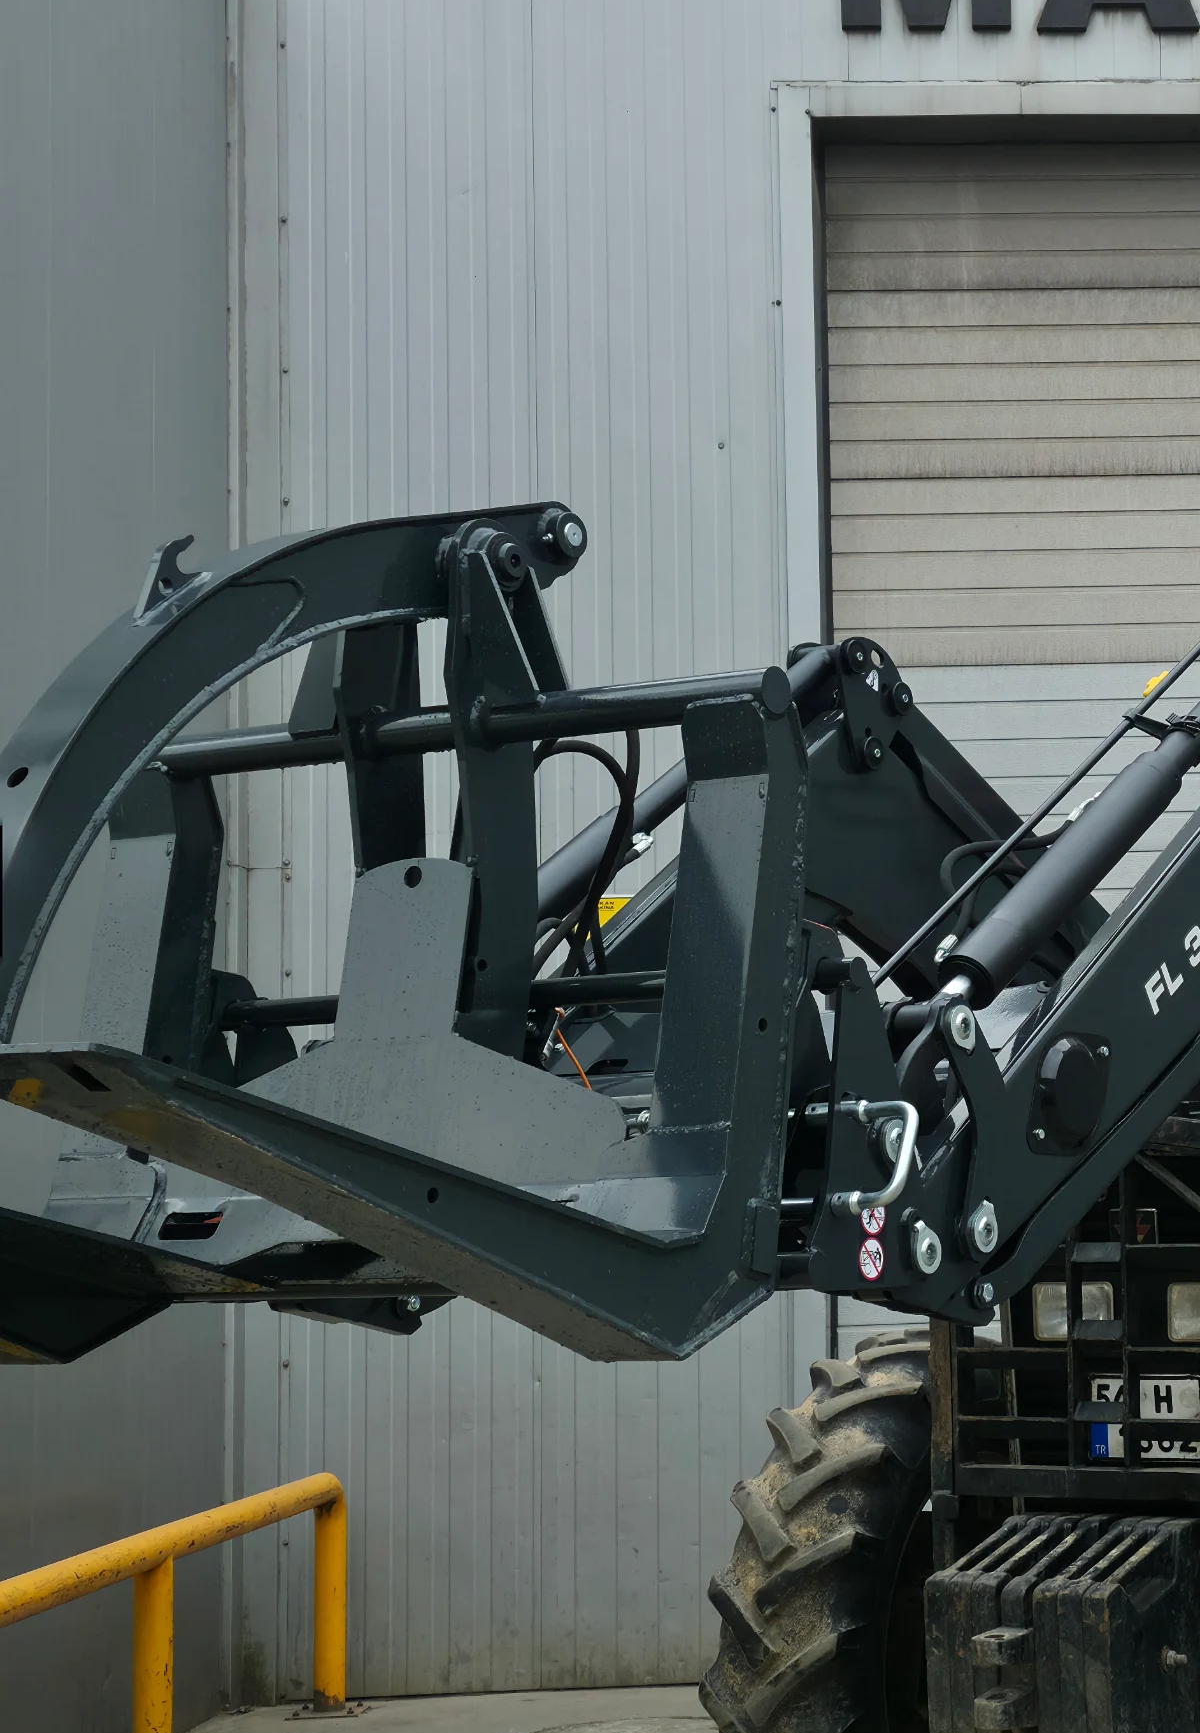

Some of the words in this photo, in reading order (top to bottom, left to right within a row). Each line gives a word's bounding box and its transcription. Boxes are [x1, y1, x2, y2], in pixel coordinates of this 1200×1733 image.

[1144, 961, 1184, 1016] FL
[1154, 1384, 1173, 1414] H
[1095, 1444, 1106, 1455] TR
